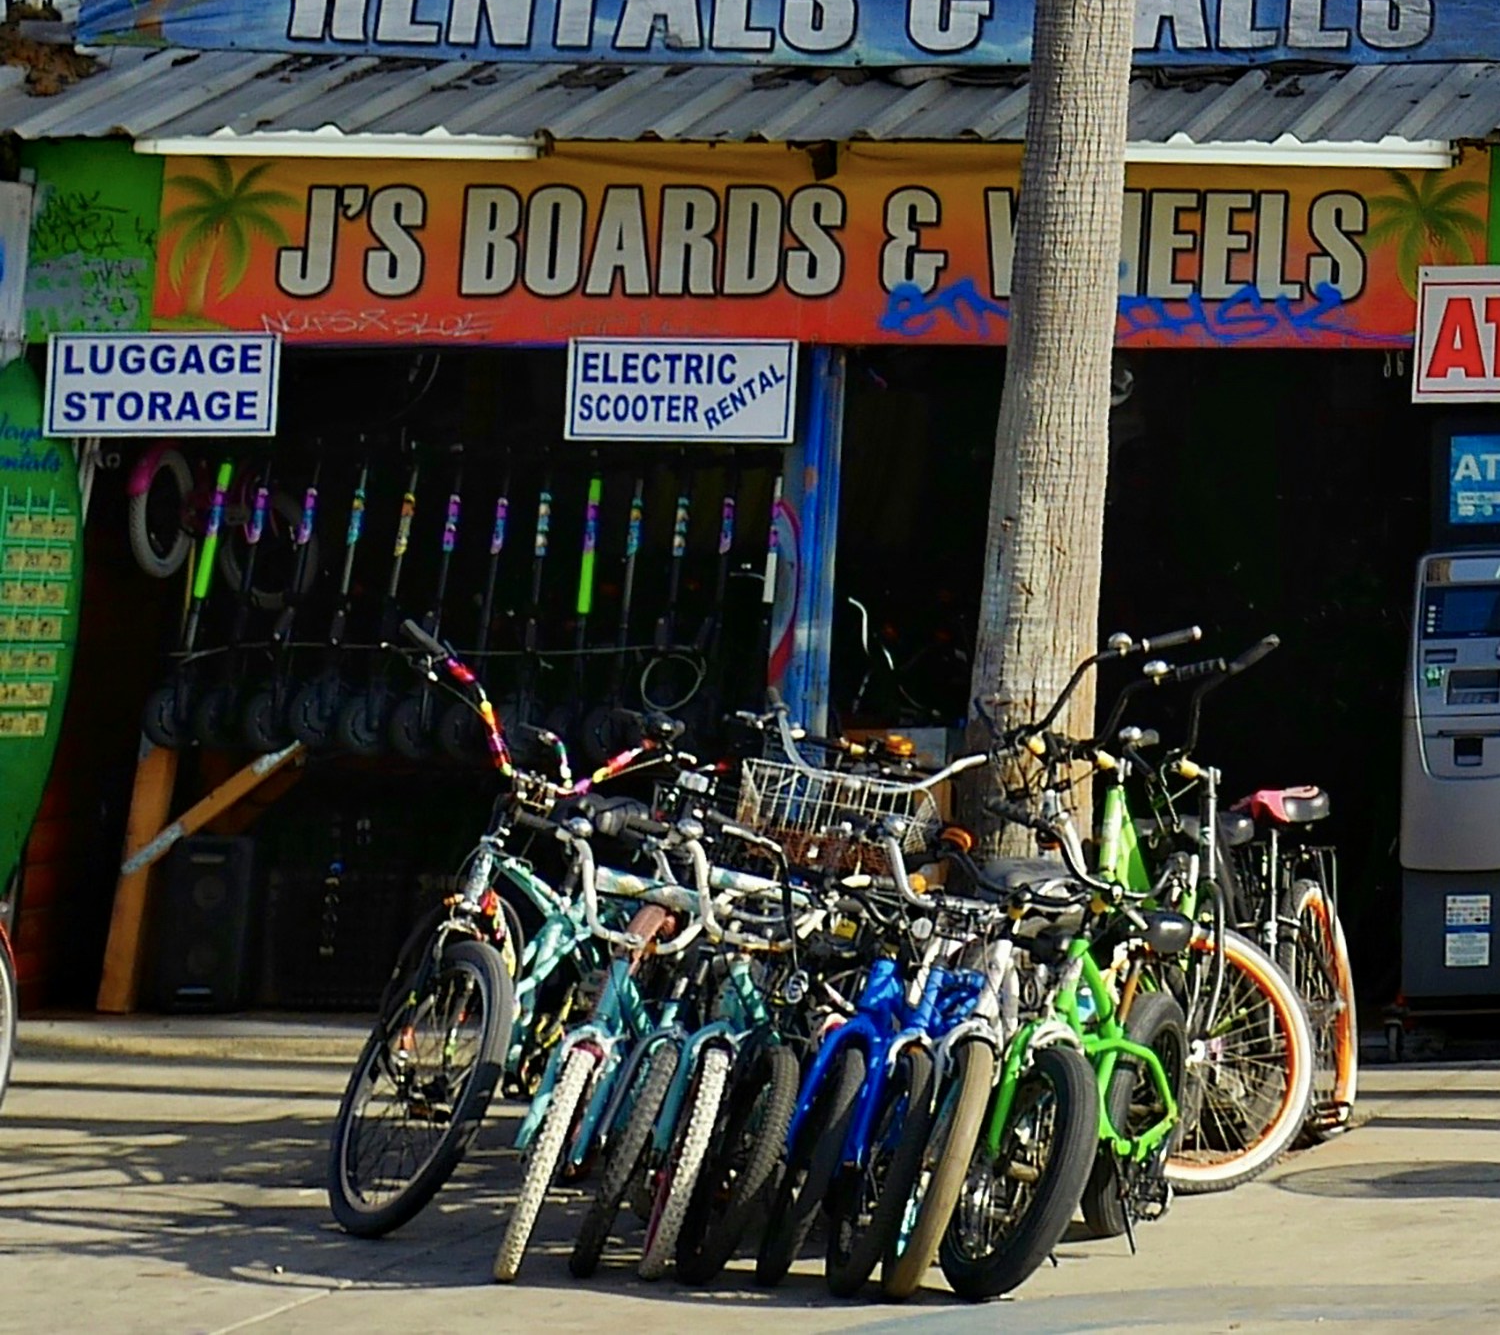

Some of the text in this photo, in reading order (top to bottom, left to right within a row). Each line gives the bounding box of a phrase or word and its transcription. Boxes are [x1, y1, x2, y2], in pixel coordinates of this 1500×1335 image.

[276, 183, 428, 298] J'S
[458, 185, 847, 298] BOARDS
[879, 185, 949, 300] &
[62, 342, 263, 376] LUGGAGE
[580, 352, 738, 387] ELECTRIC
[62, 389, 260, 423] STORAGE
[578, 363, 787, 430] SCOOTER RENTAL
